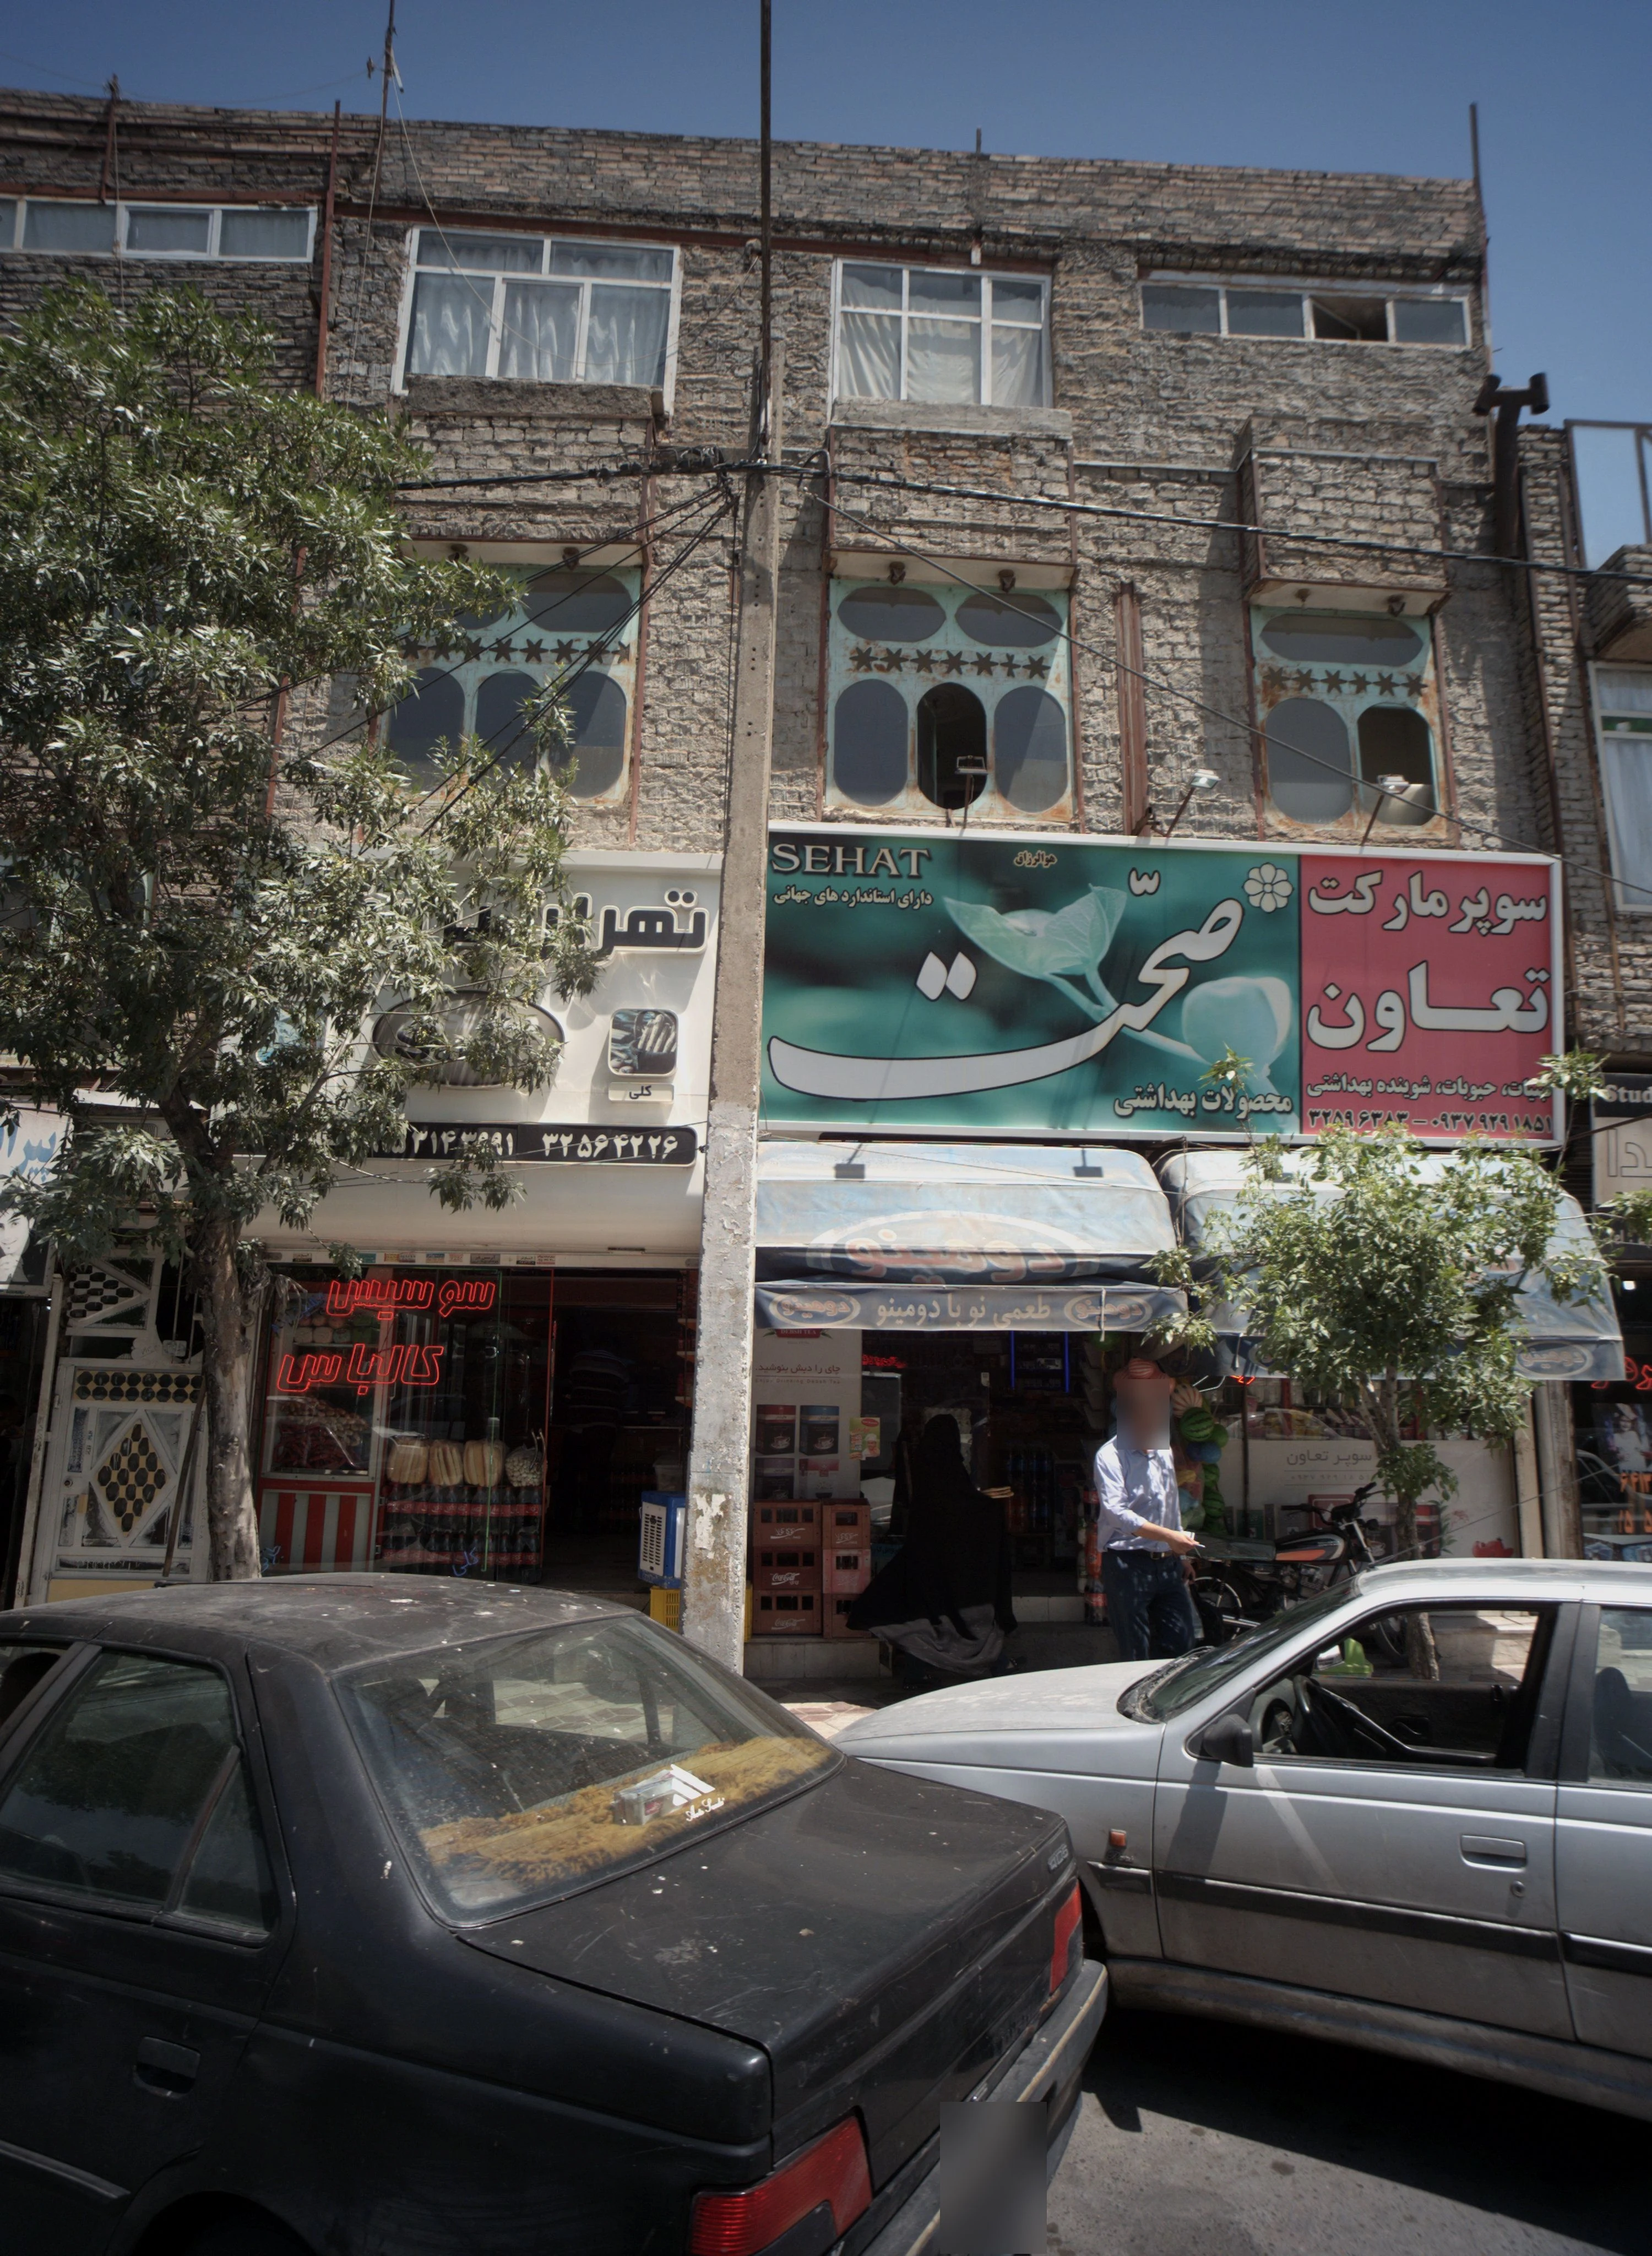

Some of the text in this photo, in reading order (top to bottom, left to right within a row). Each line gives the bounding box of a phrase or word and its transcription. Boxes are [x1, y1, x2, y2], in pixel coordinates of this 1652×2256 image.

[772, 843, 931, 877] SEHAT
[773, 884, 933, 909] دارای استاندارد های جهانی
[1307, 870, 1548, 936] سوپر مارکت
[1306, 961, 1551, 1053] تعاون
[628, 1084, 653, 1100] کلی
[1306, 1072, 1374, 1098] بهداشتی
[1376, 1075, 1431, 1100] شوینده
[1114, 1082, 1293, 1120] محصولات بهداشتی
[877, 1293, 1051, 1329] طعمی نو با دومینو
[276, 1342, 444, 1396] کالباس
[815, 1364, 823, 1374] را
[825, 1364, 841, 1375] چای
[1286, 1449, 1372, 1467] سوپر تعاون
